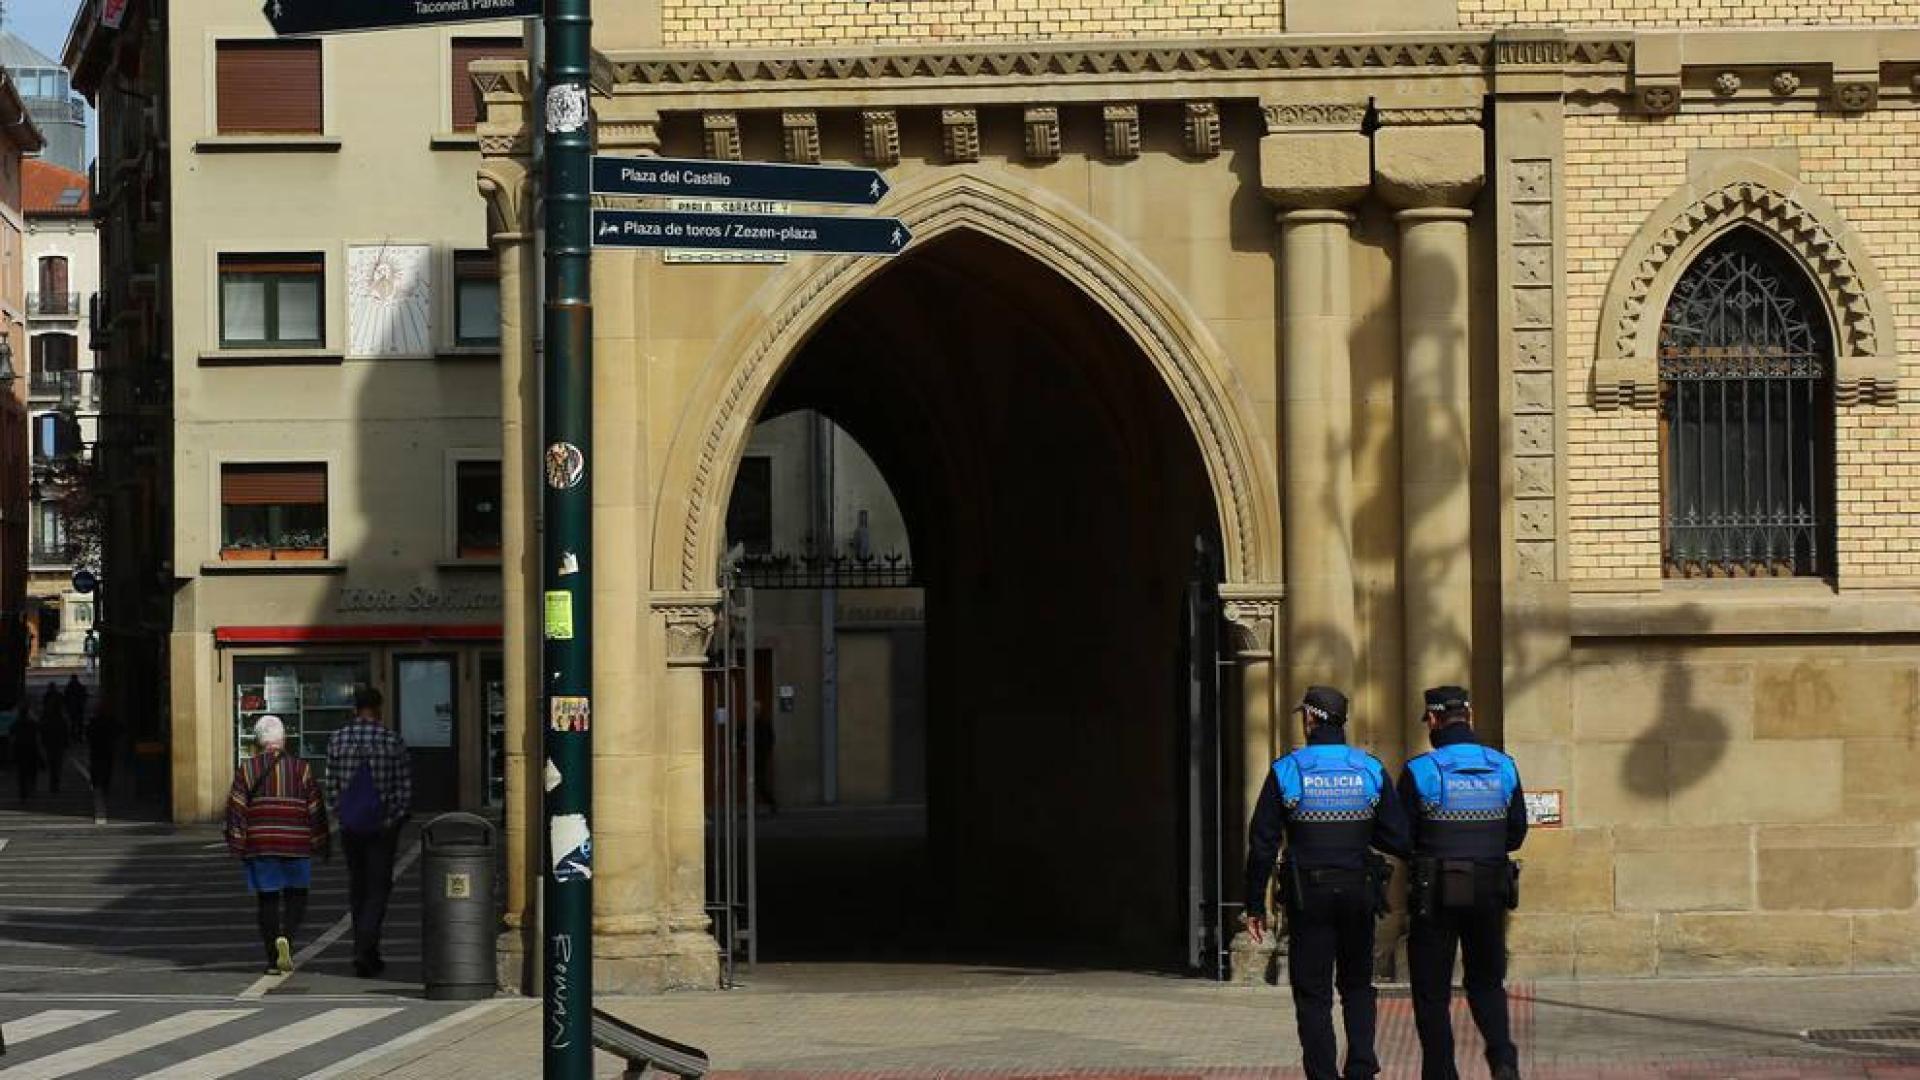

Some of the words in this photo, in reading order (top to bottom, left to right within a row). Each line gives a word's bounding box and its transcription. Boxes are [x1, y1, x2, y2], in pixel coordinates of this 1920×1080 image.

[415, 1, 469, 14] Taconera
[622, 168, 656, 182] Plaza
[660, 170, 679, 183] del
[683, 170, 731, 185] Castillo
[624, 220, 661, 235] Plaza
[665, 222, 683, 236] de
[686, 224, 722, 237] toros
[735, 224, 817, 241] Zezen-plaza
[1304, 776, 1363, 787] POLICIA
